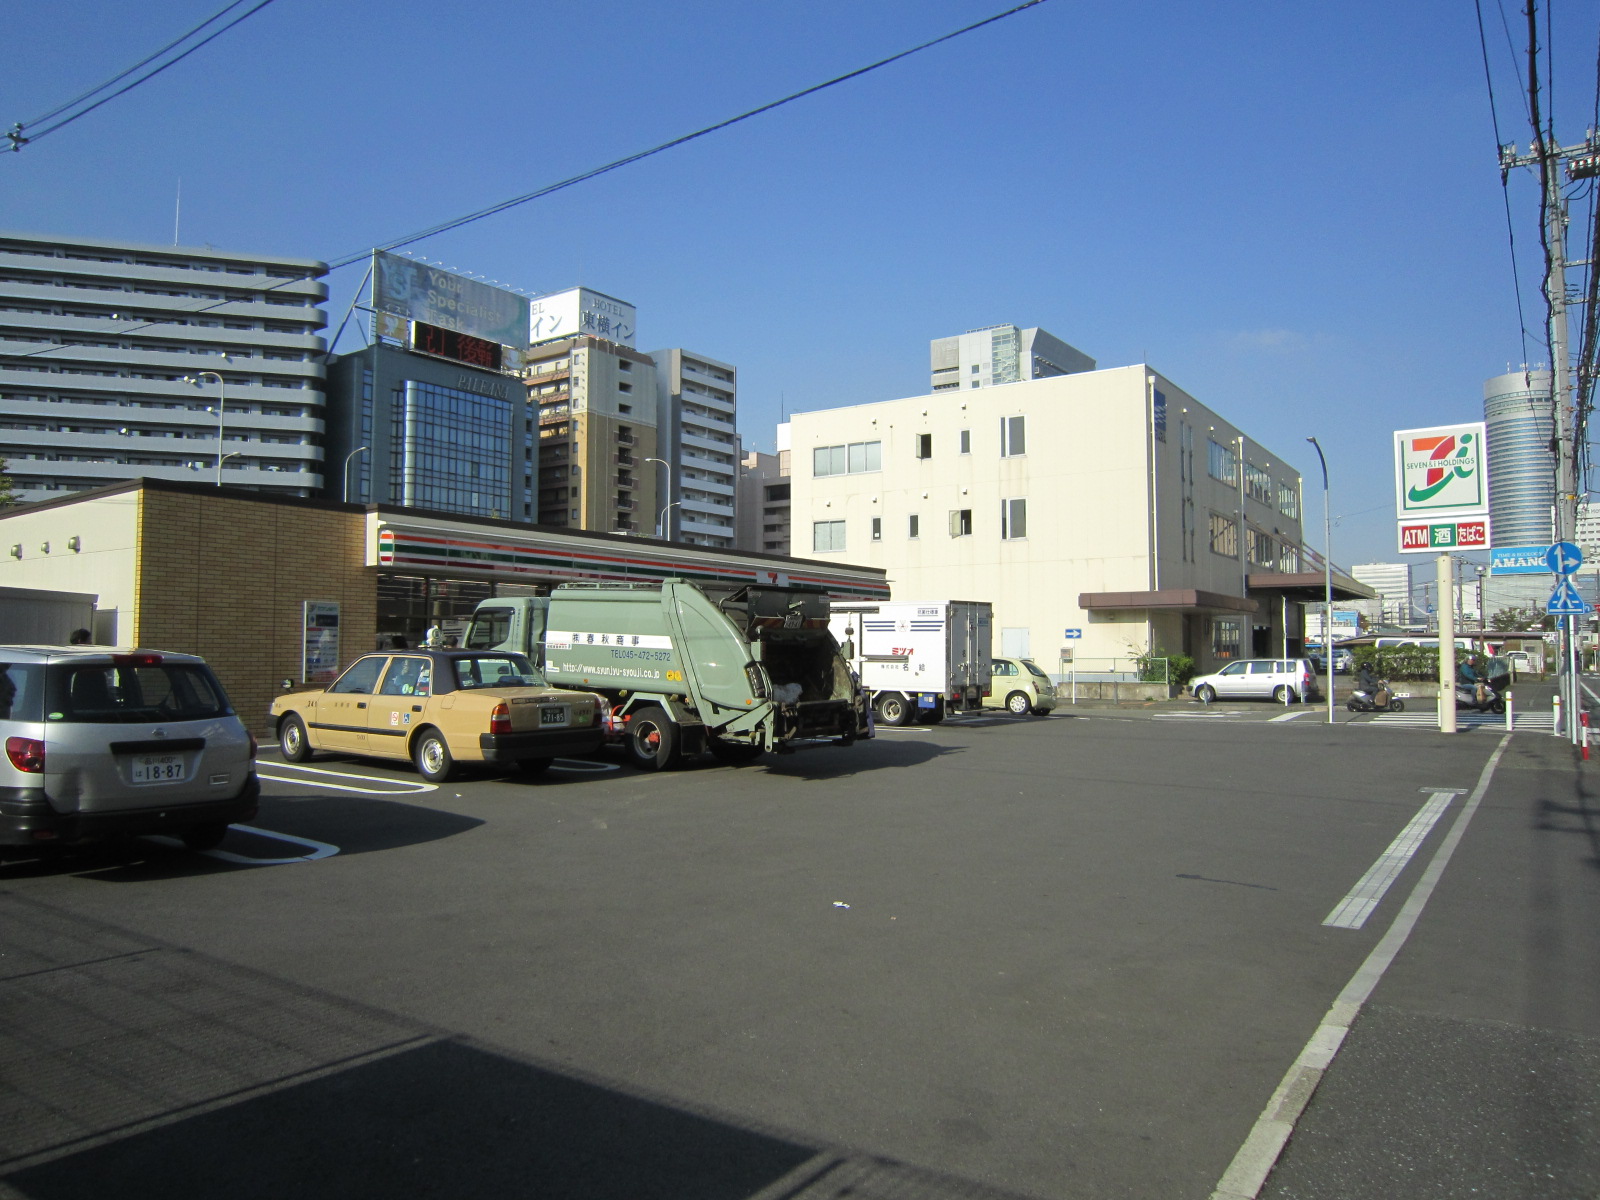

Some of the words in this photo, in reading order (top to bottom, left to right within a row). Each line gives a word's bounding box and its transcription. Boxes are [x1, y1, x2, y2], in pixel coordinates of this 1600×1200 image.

[428, 271, 463, 293] Your
[427, 290, 501, 322] Specialist
[592, 298, 624, 317] HOTEL
[428, 308, 465, 331] Task
[531, 315, 562, 338] イン
[581, 310, 635, 340] 東横イン
[1437, 458, 1475, 467] HOLDINGS
[1403, 528, 1428, 546] ATM
[1434, 527, 1451, 544] 酒
[1457, 525, 1485, 542] たばこ
[146, 764, 182, 780] 18-87
